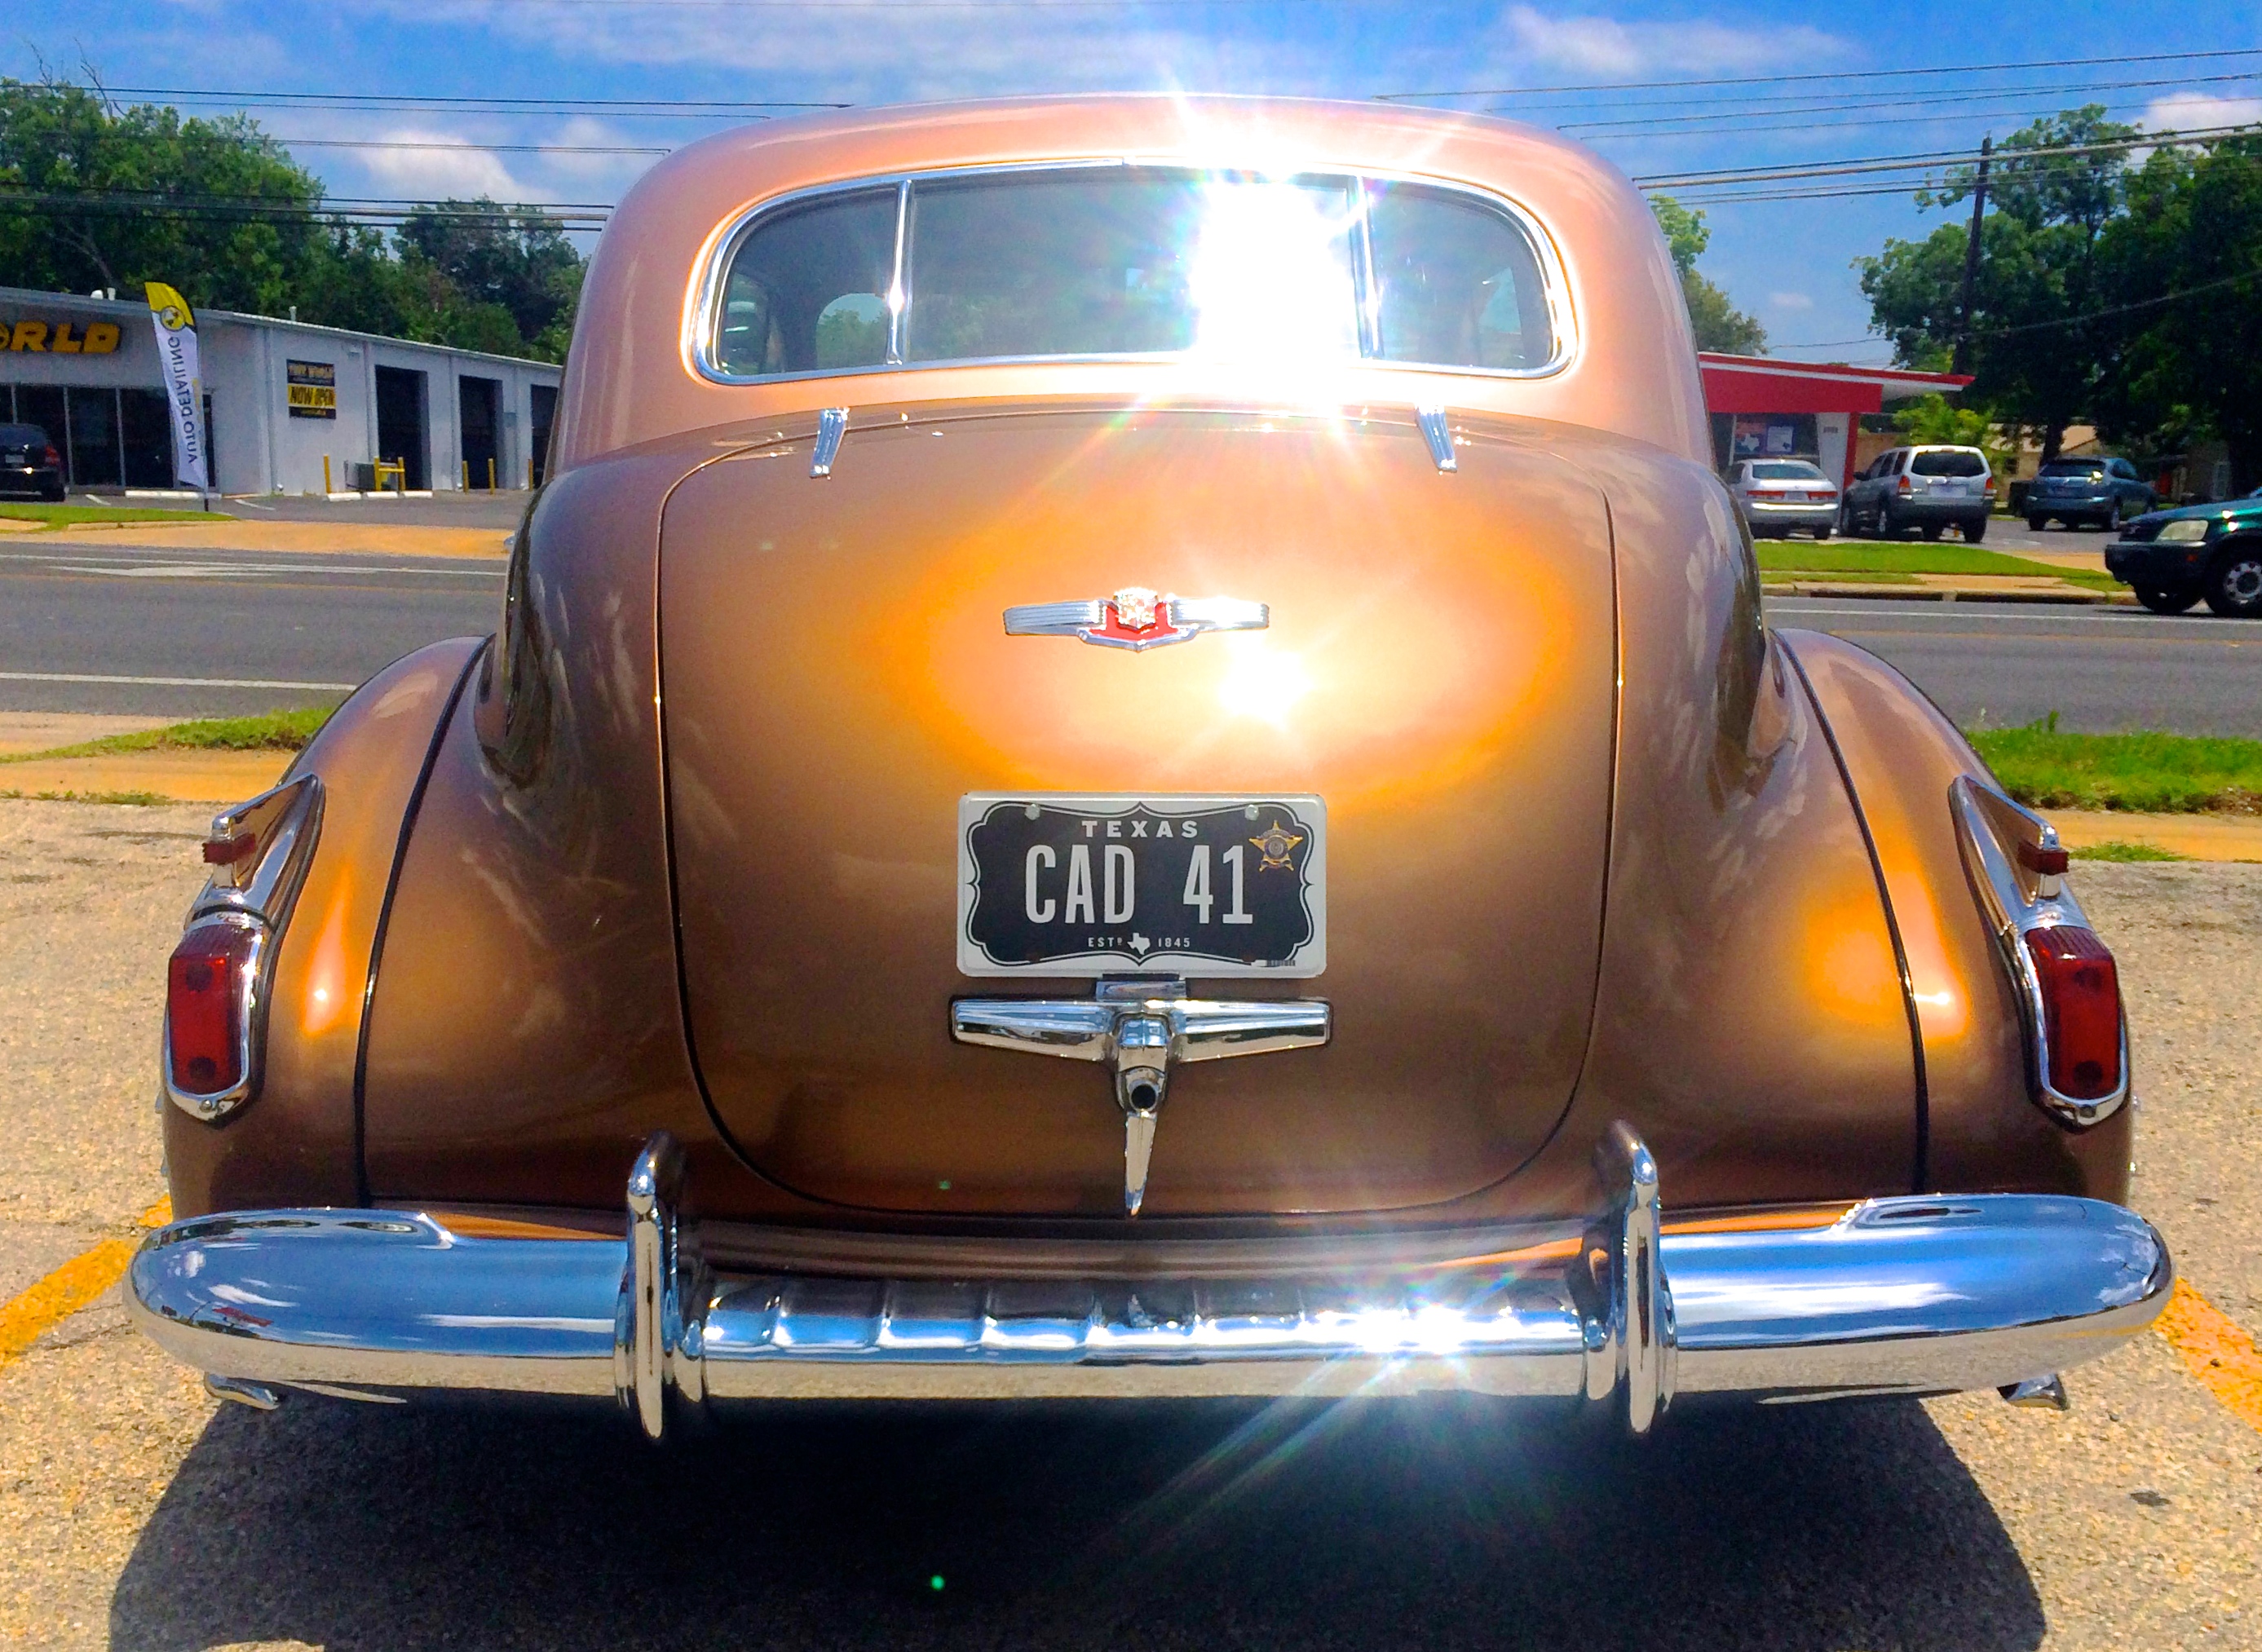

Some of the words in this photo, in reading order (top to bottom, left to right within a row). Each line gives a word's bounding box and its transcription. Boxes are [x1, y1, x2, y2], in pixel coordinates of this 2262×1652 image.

[1081, 819, 1199, 838] TEXAS
[1024, 844, 1135, 924] CAD
[1182, 845, 1254, 924] 41
[1158, 937, 1191, 947] 1845
